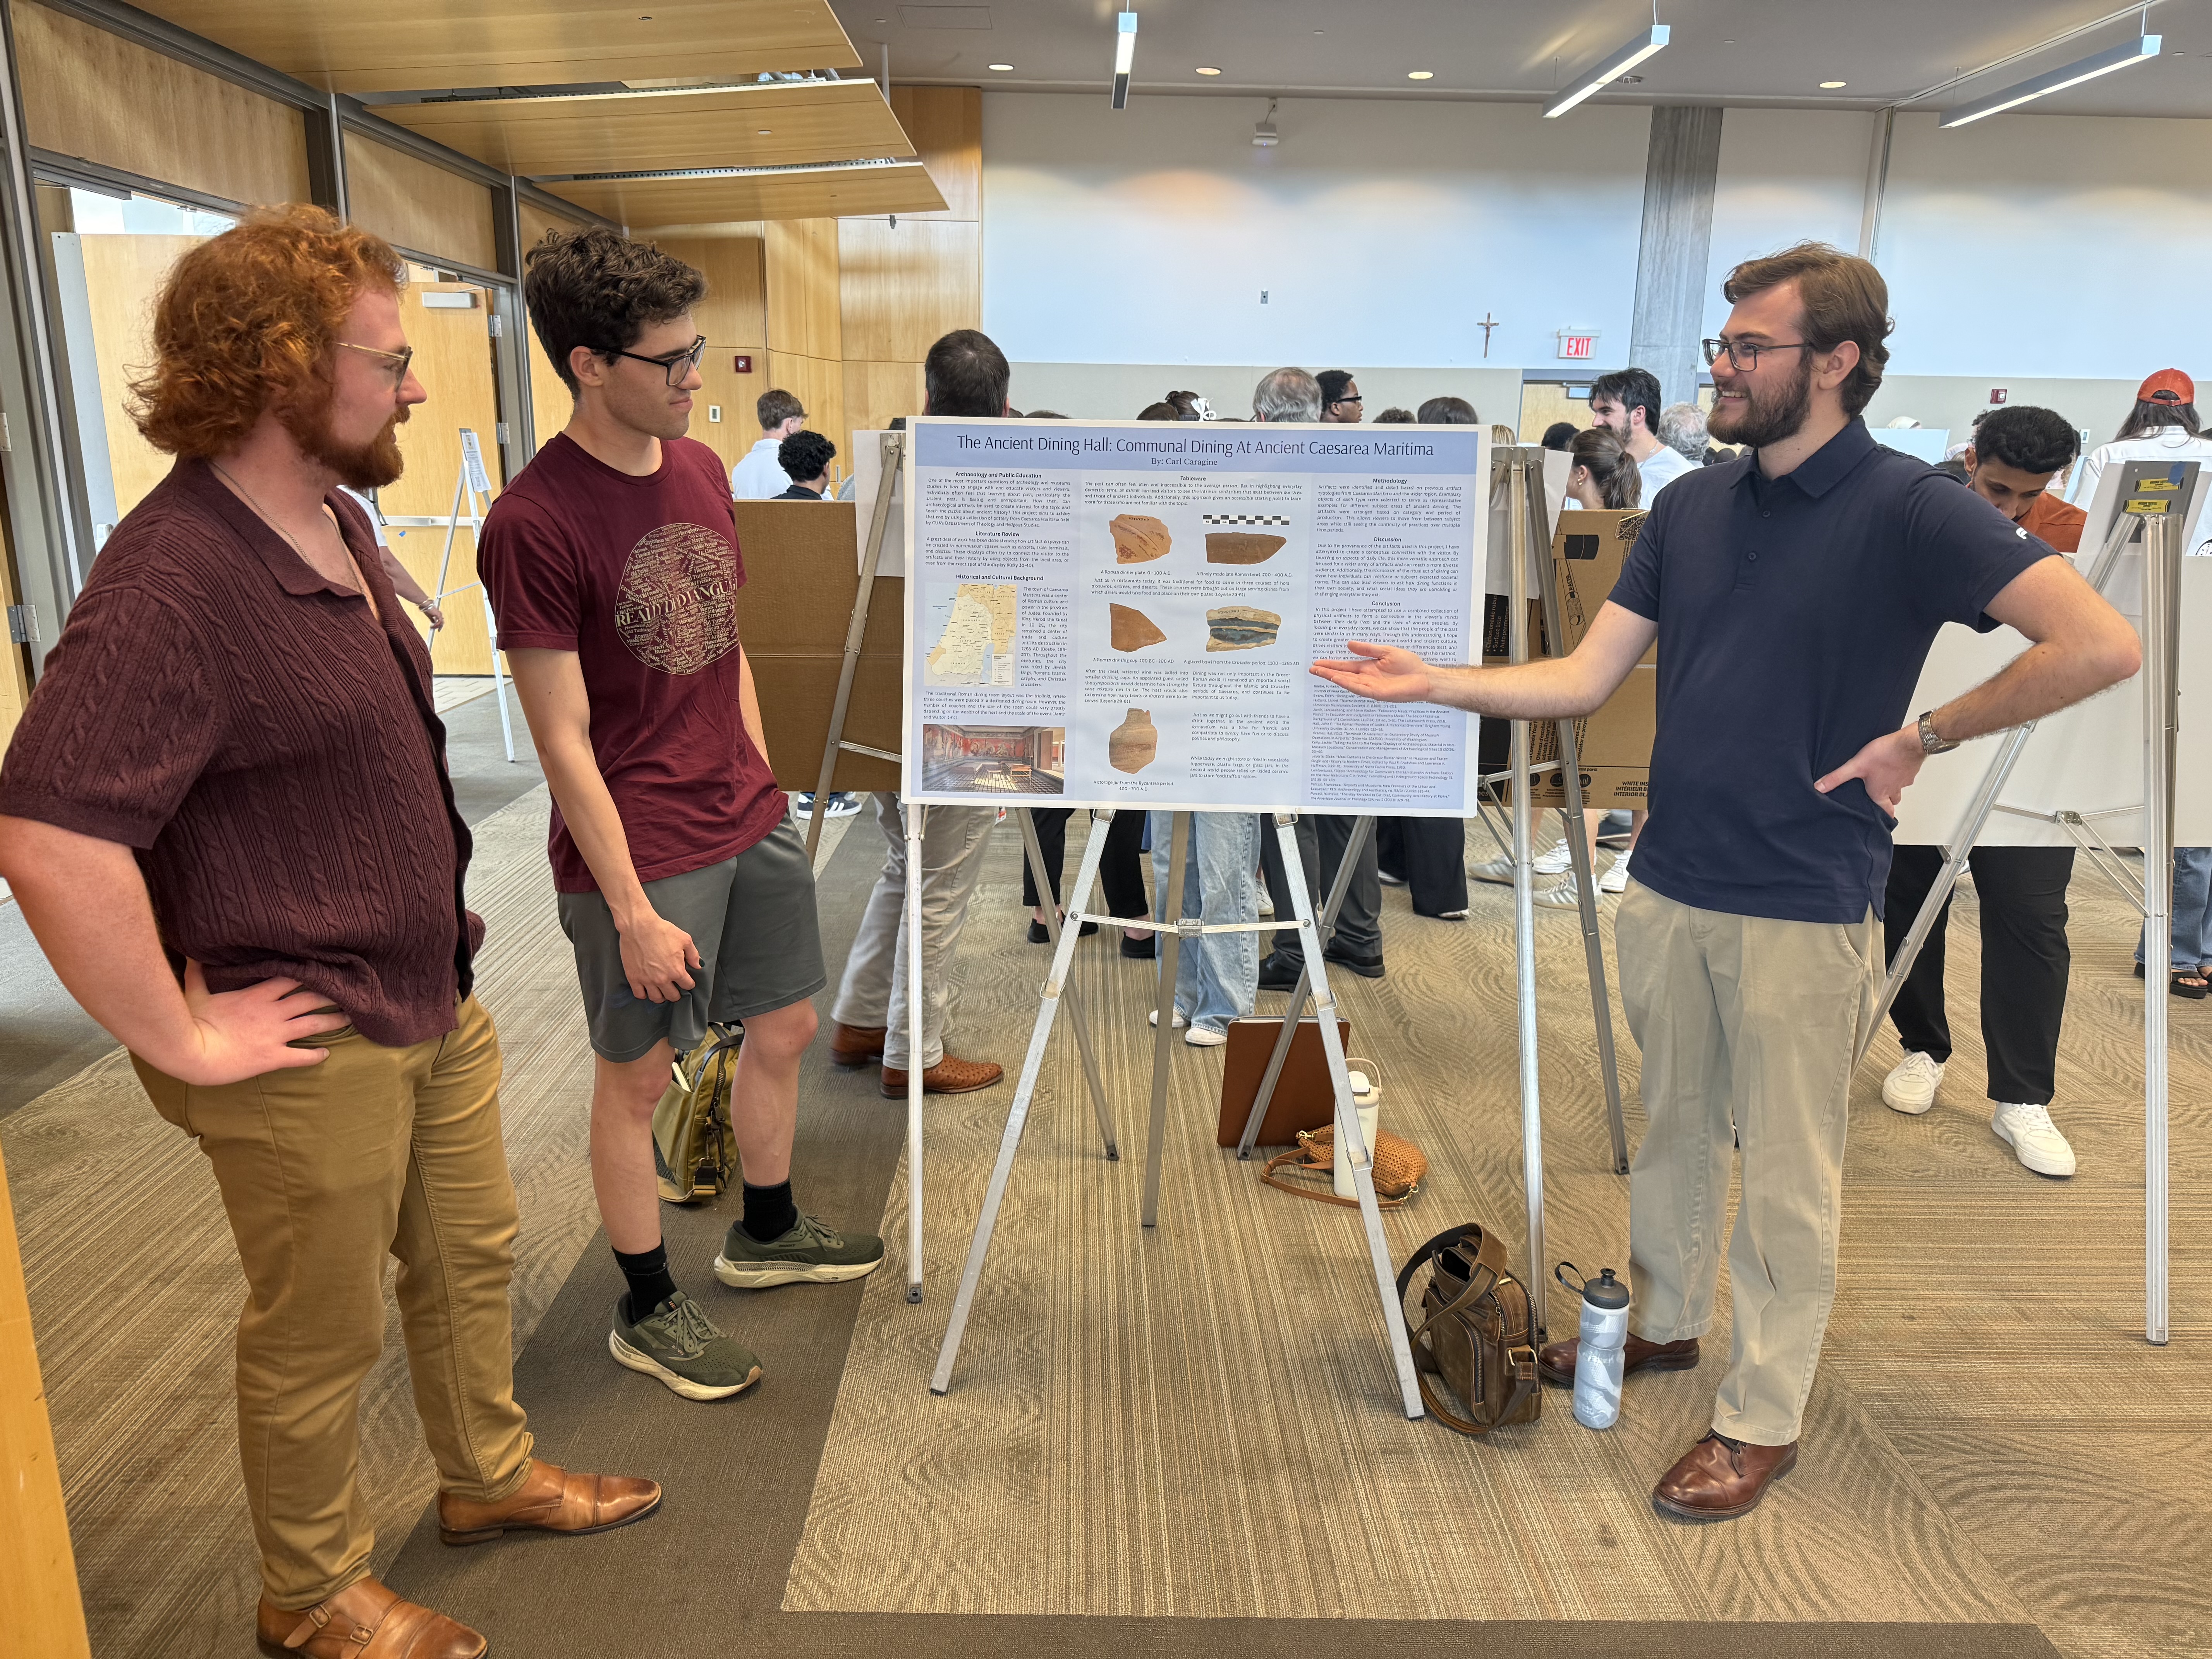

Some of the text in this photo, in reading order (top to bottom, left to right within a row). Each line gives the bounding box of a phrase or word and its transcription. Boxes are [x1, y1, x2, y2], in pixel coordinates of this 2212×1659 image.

[1567, 337, 1591, 356] EXIT
[957, 434, 1433, 457] The Ancient Dining Hall: Communal Dining At Ancient Caesarea Maritima
